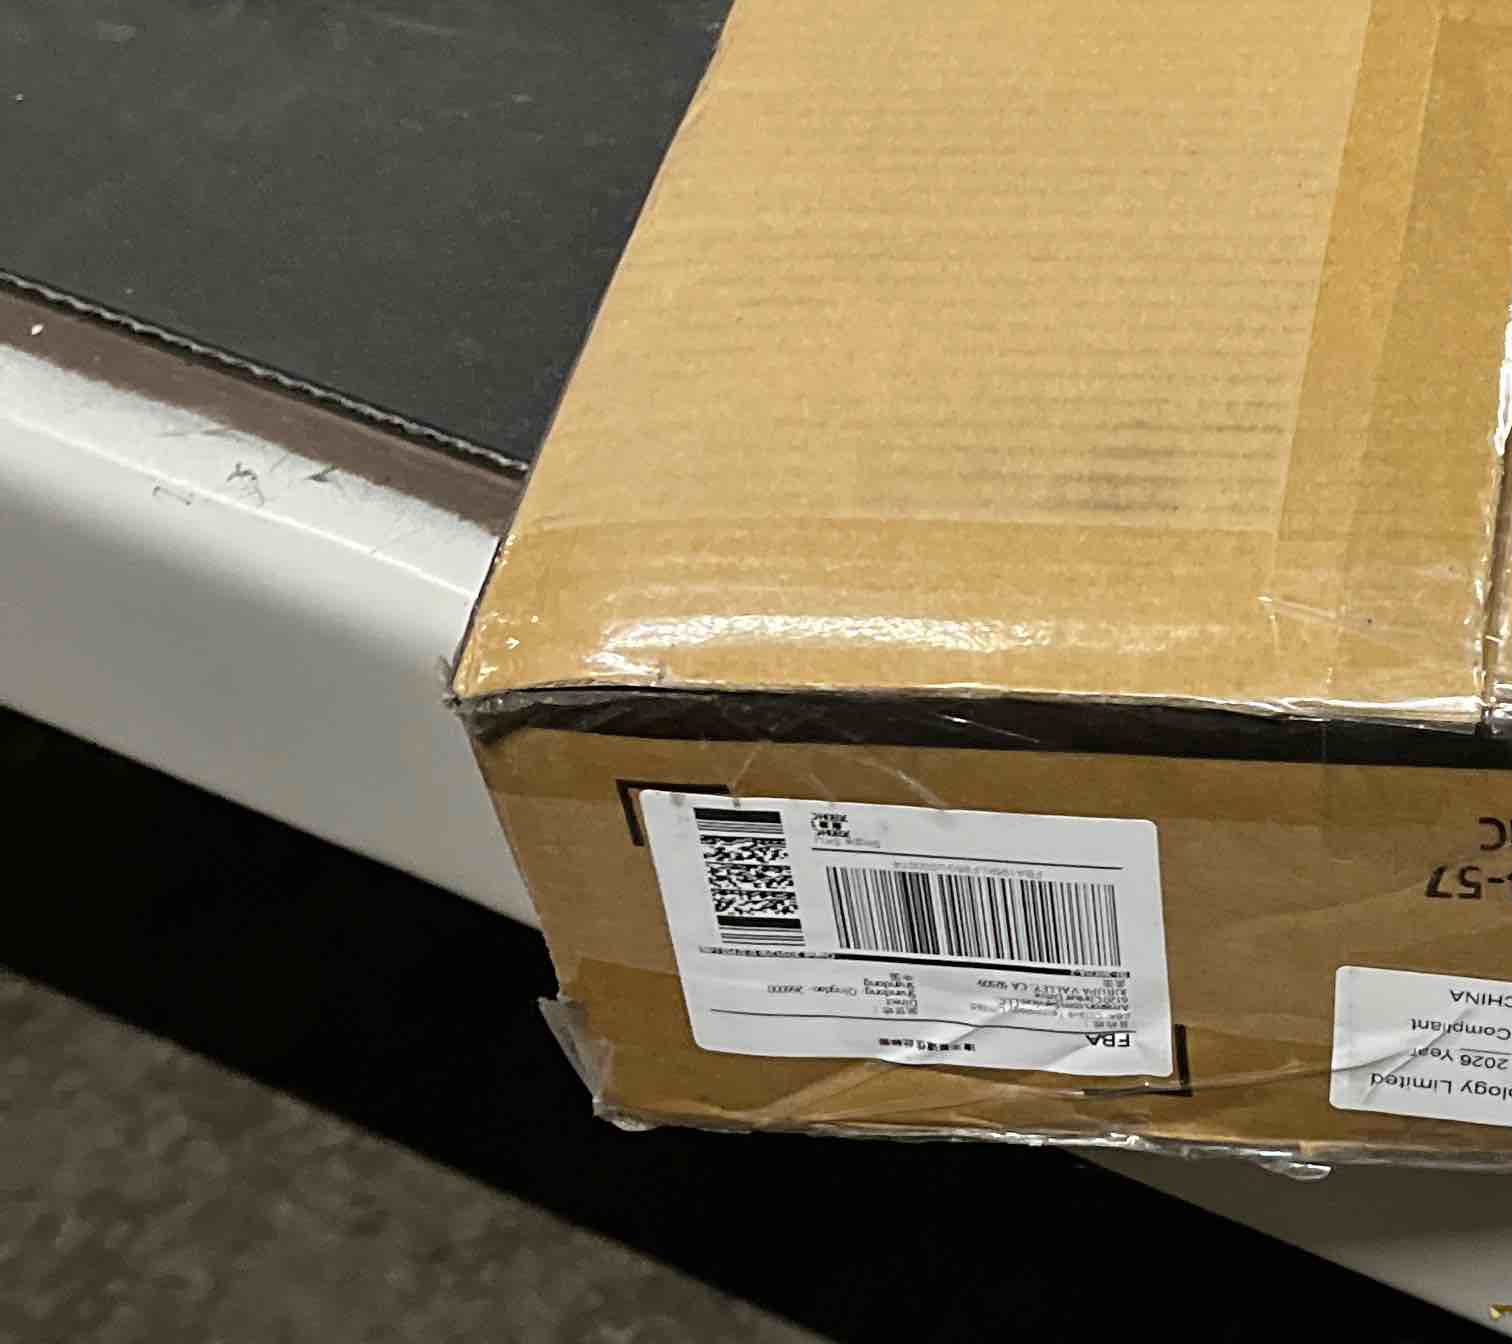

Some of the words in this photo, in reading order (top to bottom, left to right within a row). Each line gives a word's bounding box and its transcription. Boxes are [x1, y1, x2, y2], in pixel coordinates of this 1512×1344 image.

[1410, 1018, 1512, 1041] Compliant
[1085, 1033, 1131, 1047] FBA
[1410, 1047, 1454, 1061] Year
[1369, 1072, 1452, 1094] Limited
